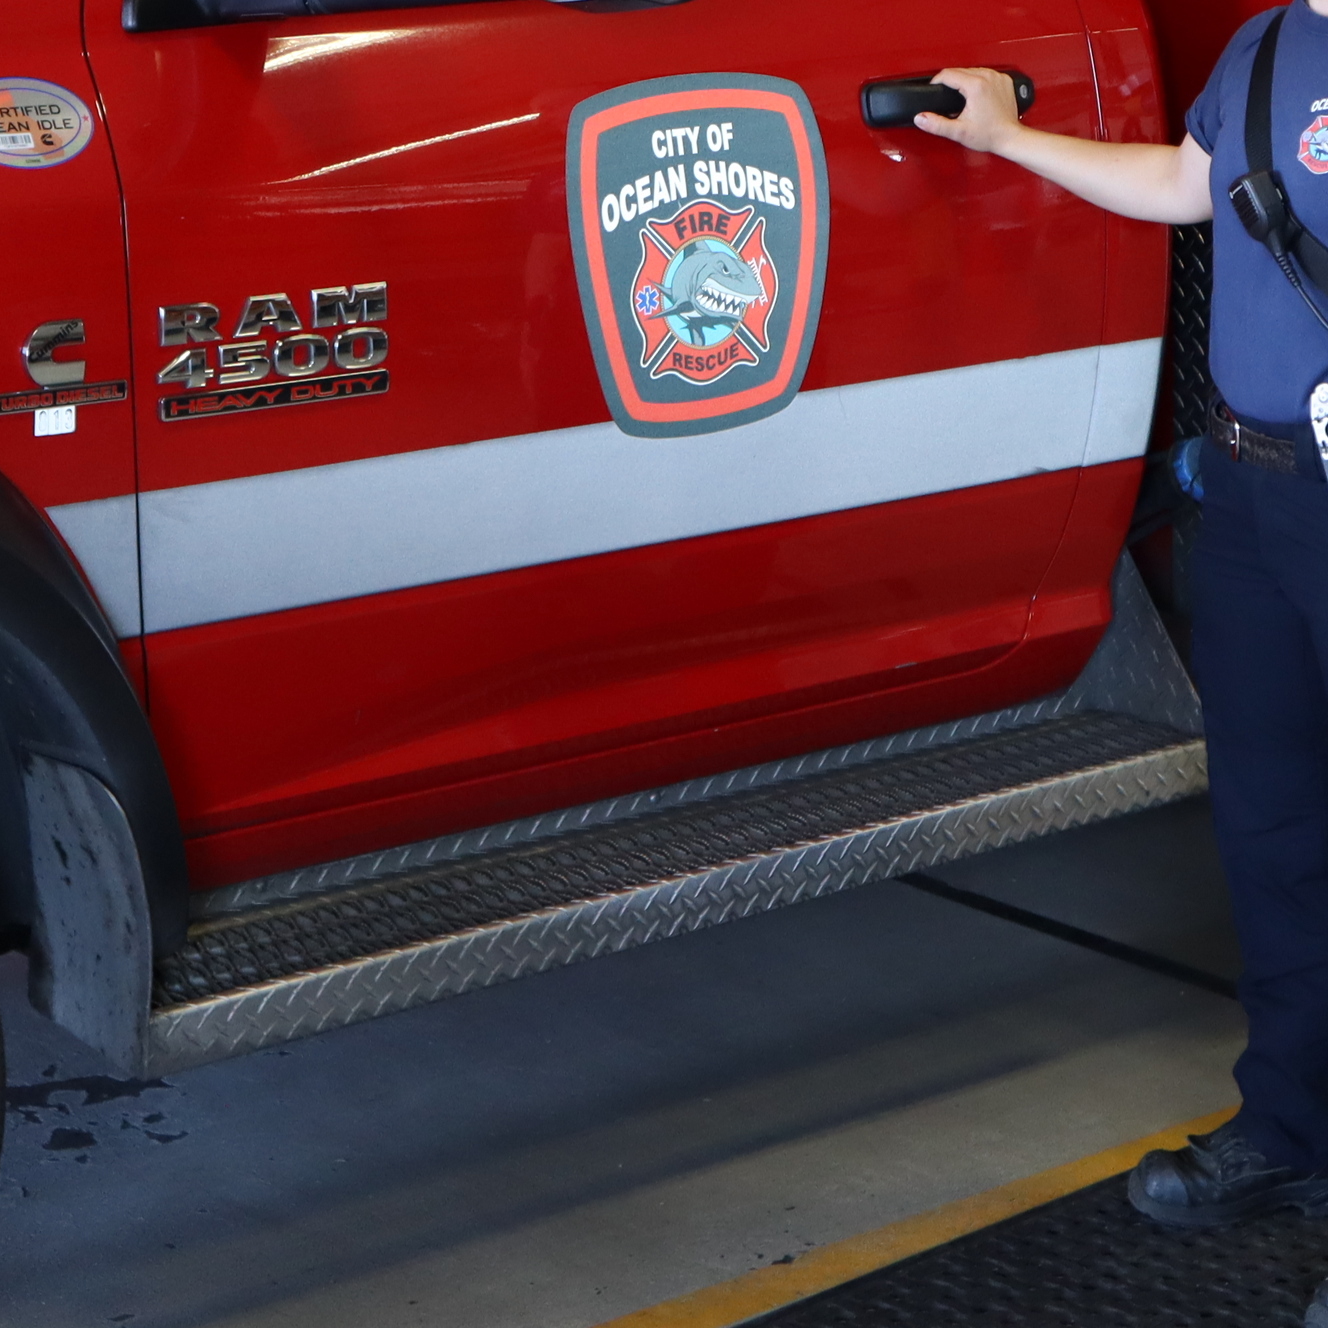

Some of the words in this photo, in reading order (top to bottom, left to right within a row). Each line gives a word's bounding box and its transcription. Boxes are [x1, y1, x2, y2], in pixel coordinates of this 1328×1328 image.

[36, 118, 74, 131] IDLE
[651, 126, 701, 160] CITY
[706, 122, 734, 153] OF
[600, 163, 688, 233] OCEAN
[693, 160, 796, 211] SHORES
[672, 210, 732, 242] FIRE
[158, 280, 388, 347] RAM
[156, 326, 389, 389] 4500
[672, 342, 741, 372] RESCUE
[56, 385, 123, 406] DIESEL
[171, 388, 283, 416] HEAVY
[290, 375, 383, 402] DUTY
